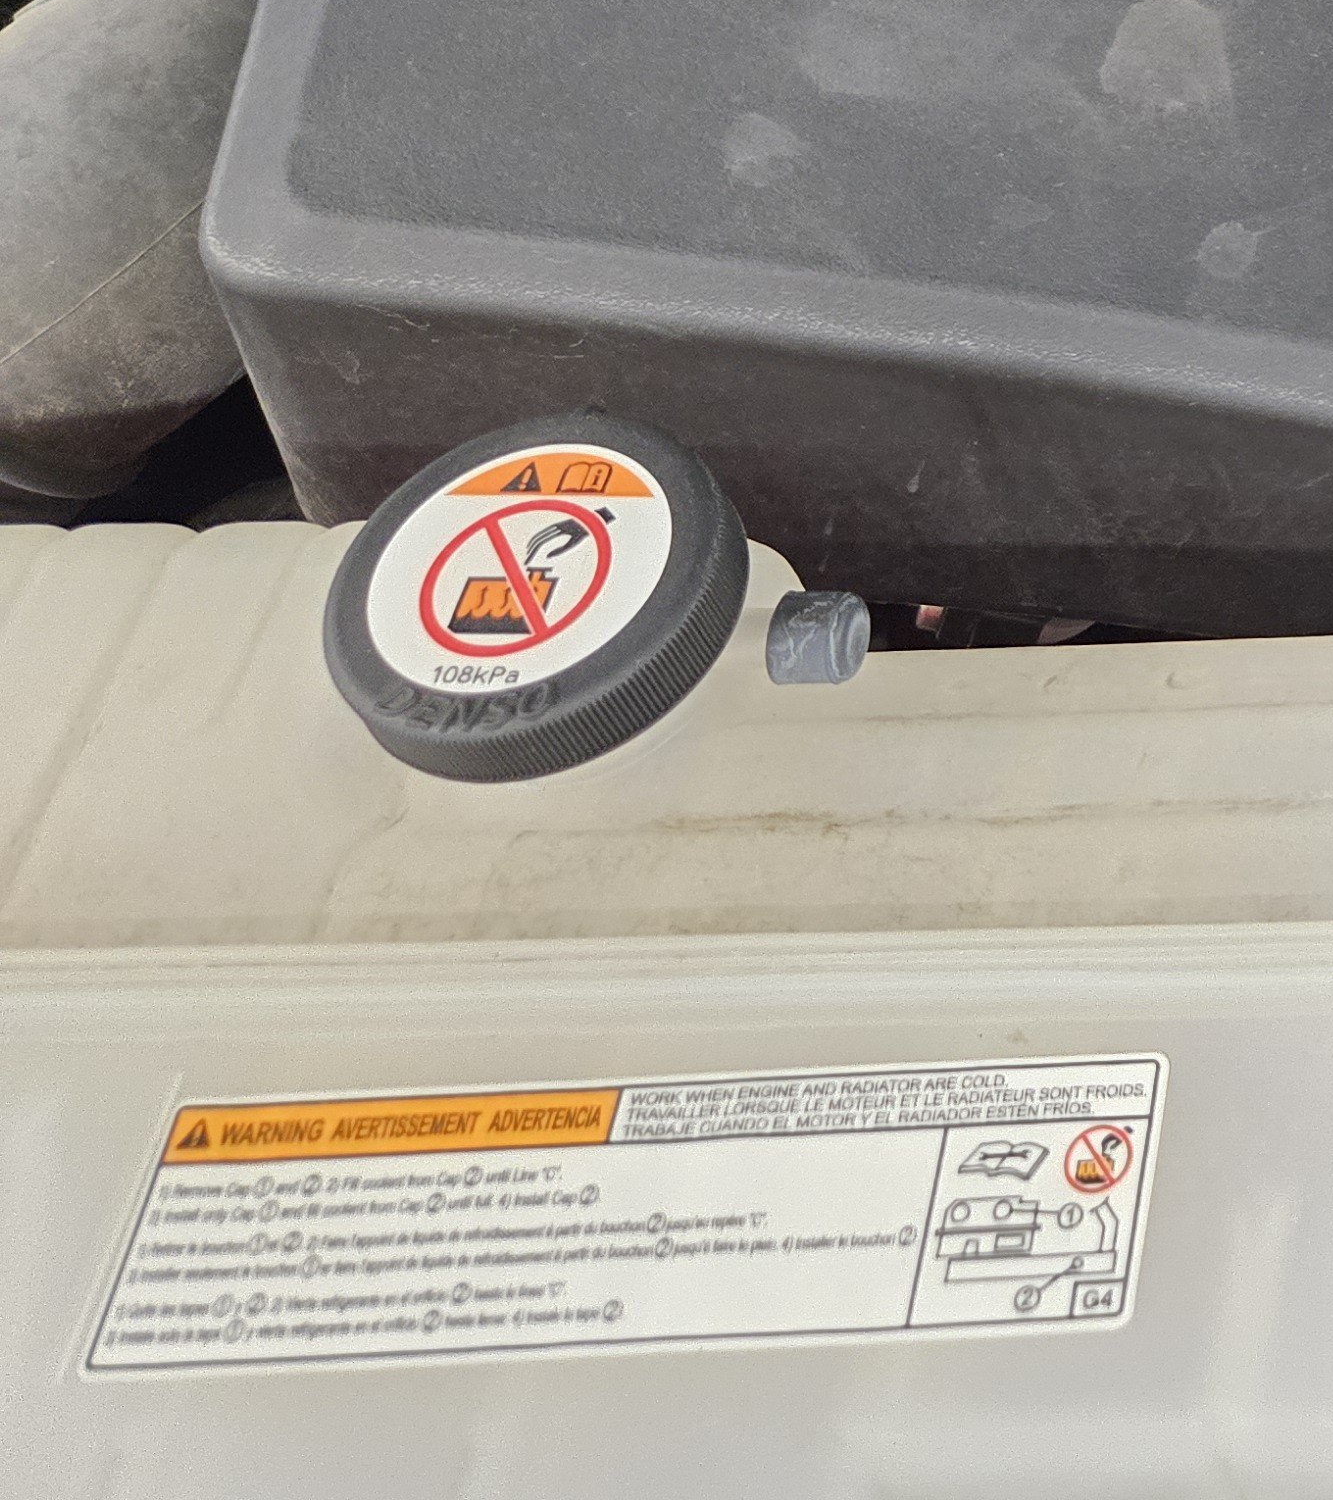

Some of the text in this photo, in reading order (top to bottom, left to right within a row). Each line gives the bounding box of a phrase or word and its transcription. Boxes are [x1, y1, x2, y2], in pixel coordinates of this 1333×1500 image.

[432, 664, 520, 685] 108kPa
[373, 681, 551, 734] DENSO
[627, 1082, 1148, 1122] TRAVAILLER LORSQUE LE MOTEUR ET LE RADIATEUR SONT FROIDS.
[631, 1073, 1008, 1106] WORK WHEN ENGINE AND RADIATOR ARE COLD.
[220, 1104, 602, 1147] WARNING AVERTISSEMENT ADVERTENCIA
[622, 1117, 695, 1138] TRABAJE
[699, 1114, 771, 1134] CUANDO
[773, 1113, 791, 1130] EL
[796, 1110, 857, 1128] MOTOR
[859, 1109, 870, 1126] Y
[874, 1109, 892, 1125] EL
[898, 1103, 982, 1123] RADIADOR
[1082, 1288, 1114, 1311] G4
